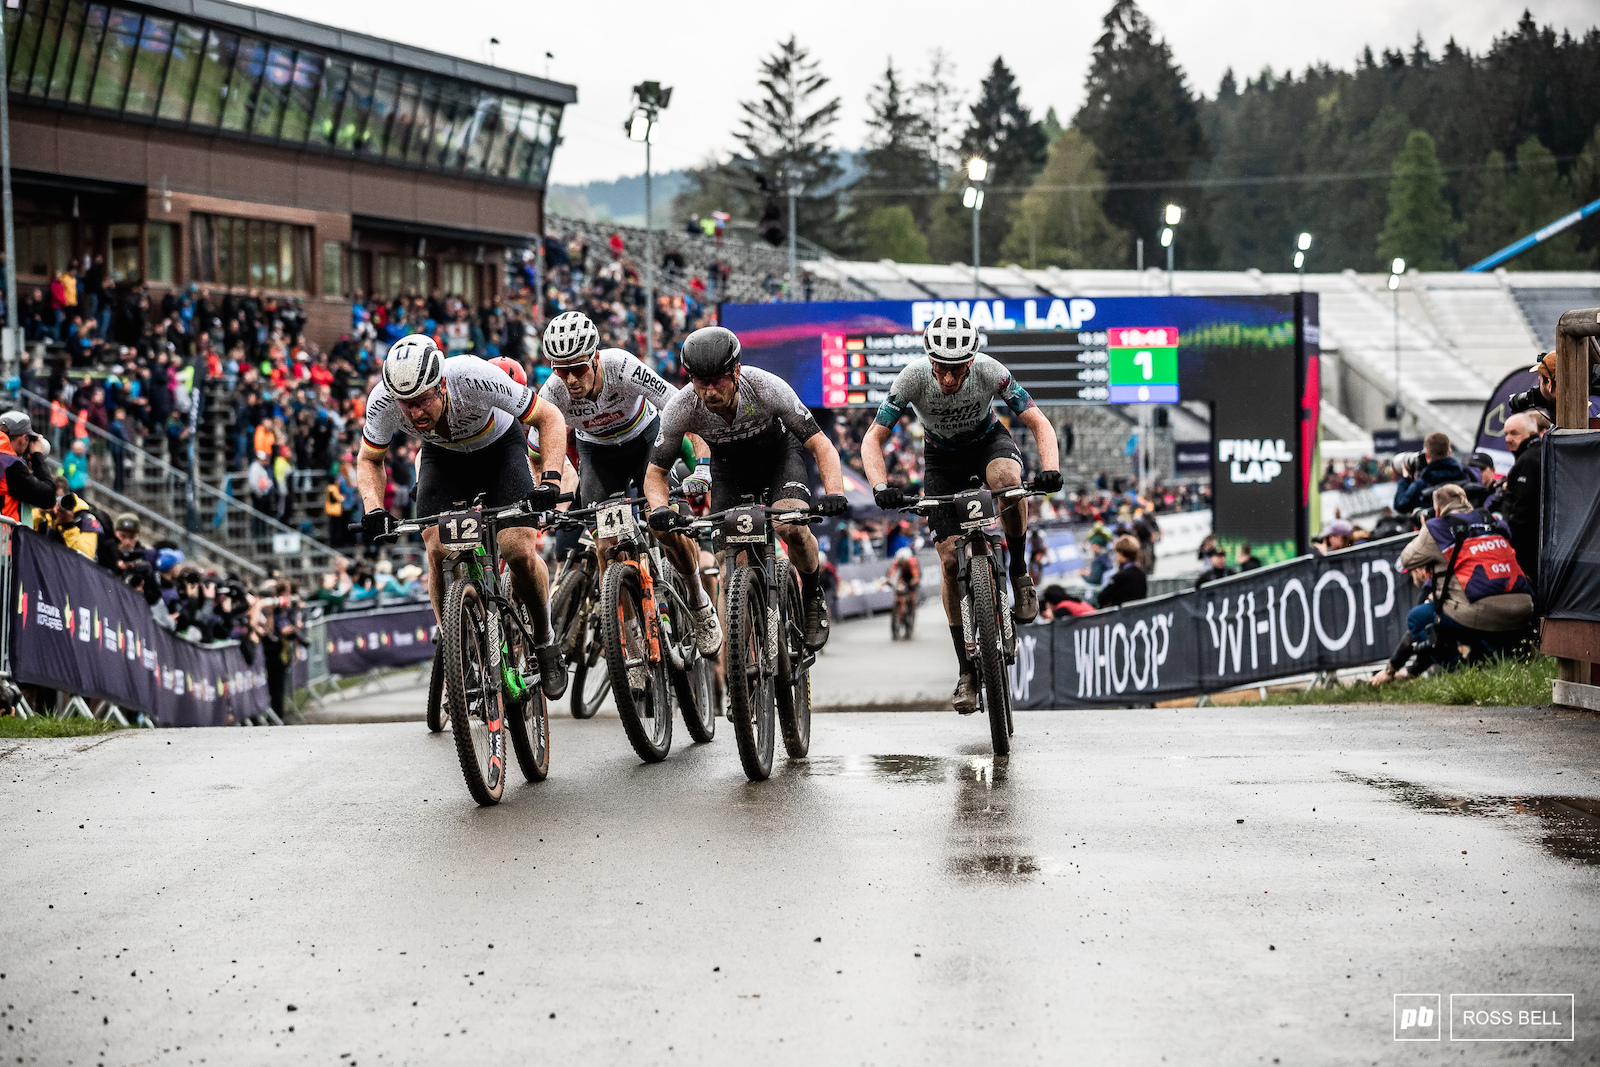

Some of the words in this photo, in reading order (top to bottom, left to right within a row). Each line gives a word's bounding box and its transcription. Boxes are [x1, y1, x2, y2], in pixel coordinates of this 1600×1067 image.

[912, 301, 1016, 331] FINAL
[1024, 299, 1096, 330] LAP
[1133, 351, 1153, 380] 1
[465, 377, 513, 398] CANYON
[632, 365, 667, 395] Alpecin
[929, 401, 982, 417] SANTA
[940, 410, 982, 423] CRUZ
[1218, 438, 1293, 462] FINAL
[1230, 460, 1282, 483] LAP
[604, 508, 624, 529] 41
[966, 500, 984, 519] 2
[446, 518, 479, 539] 12
[736, 514, 754, 533] 3
[1469, 539, 1508, 555] PHOTO
[1491, 562, 1511, 574] 031
[1205, 558, 1395, 676] WHOOP
[1074, 612, 1173, 698] WHOOP
